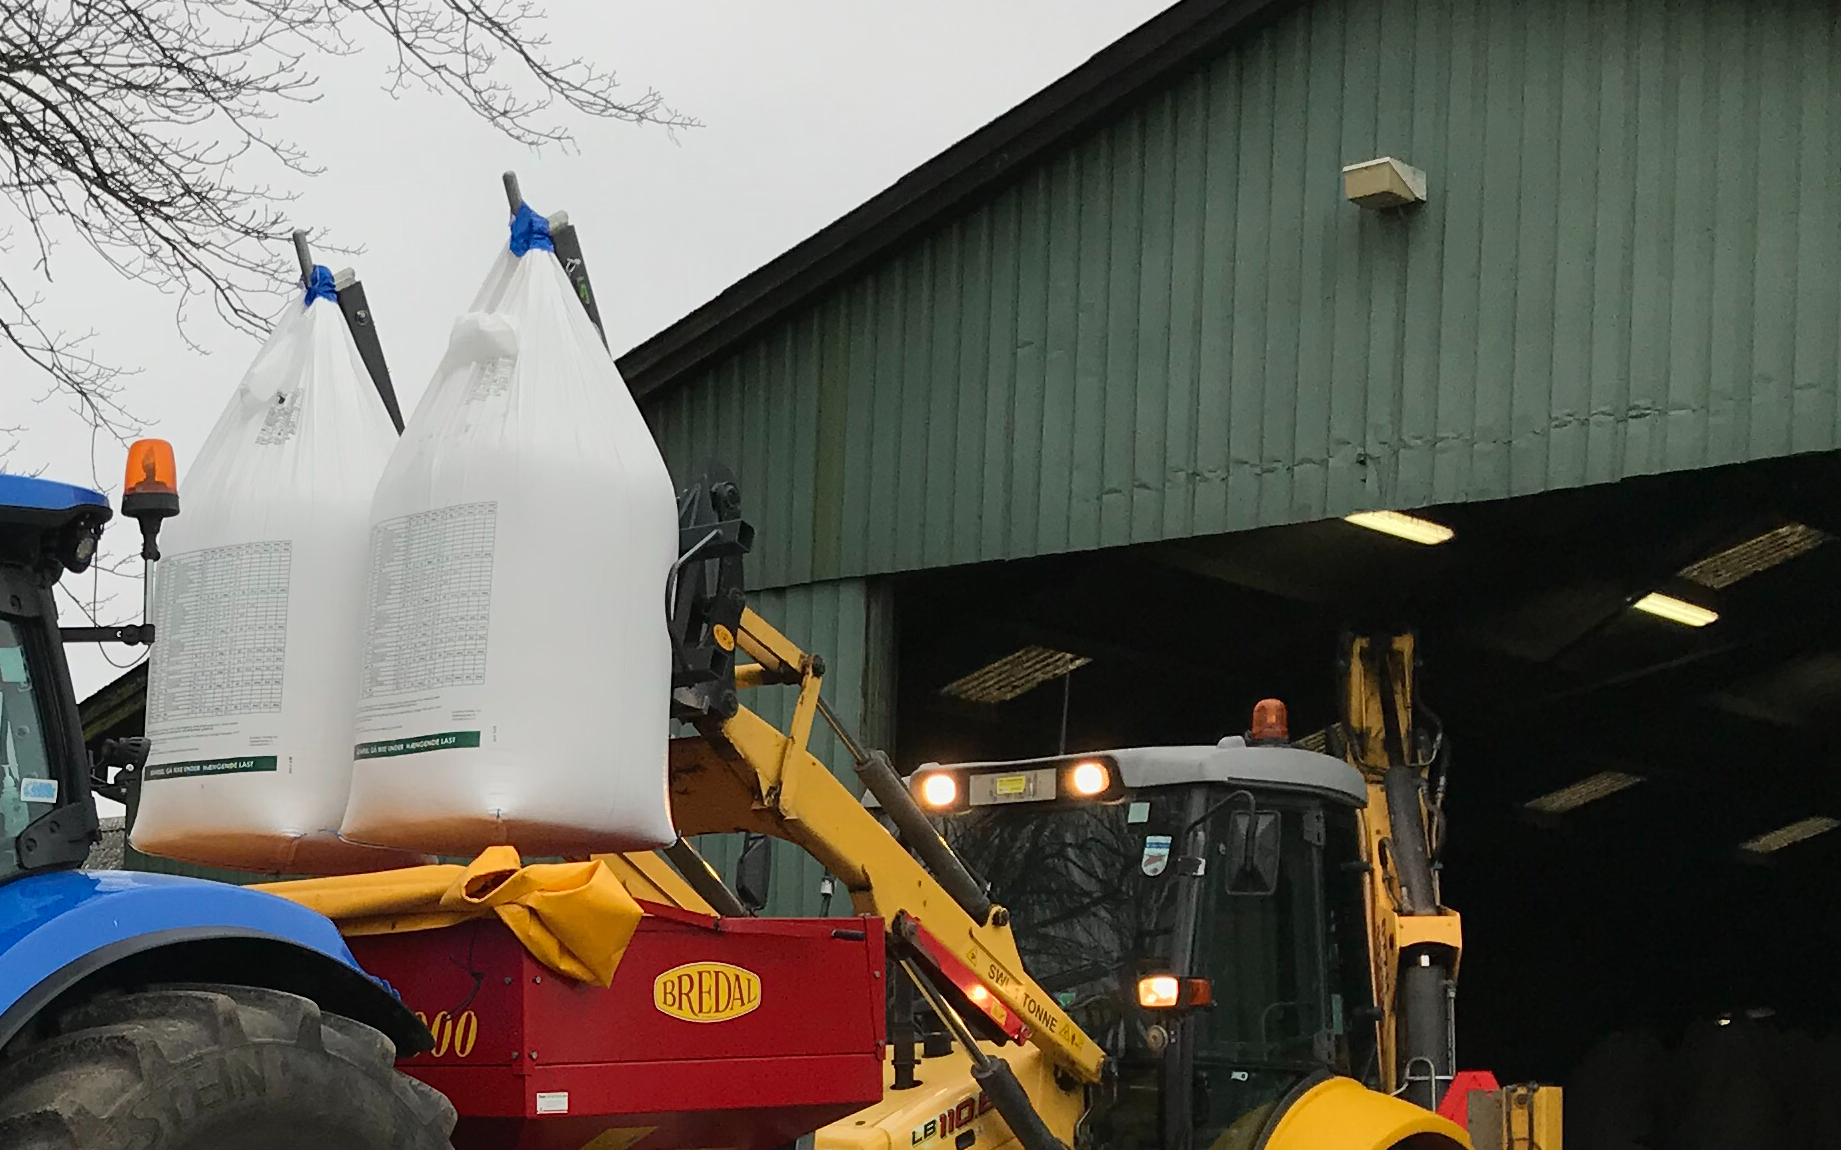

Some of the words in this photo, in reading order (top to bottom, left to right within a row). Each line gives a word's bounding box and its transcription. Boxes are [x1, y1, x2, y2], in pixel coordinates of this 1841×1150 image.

[238, 760, 254, 768] LAST
[662, 970, 758, 1017] BREDAL
[1022, 992, 1058, 1033] TONNE
